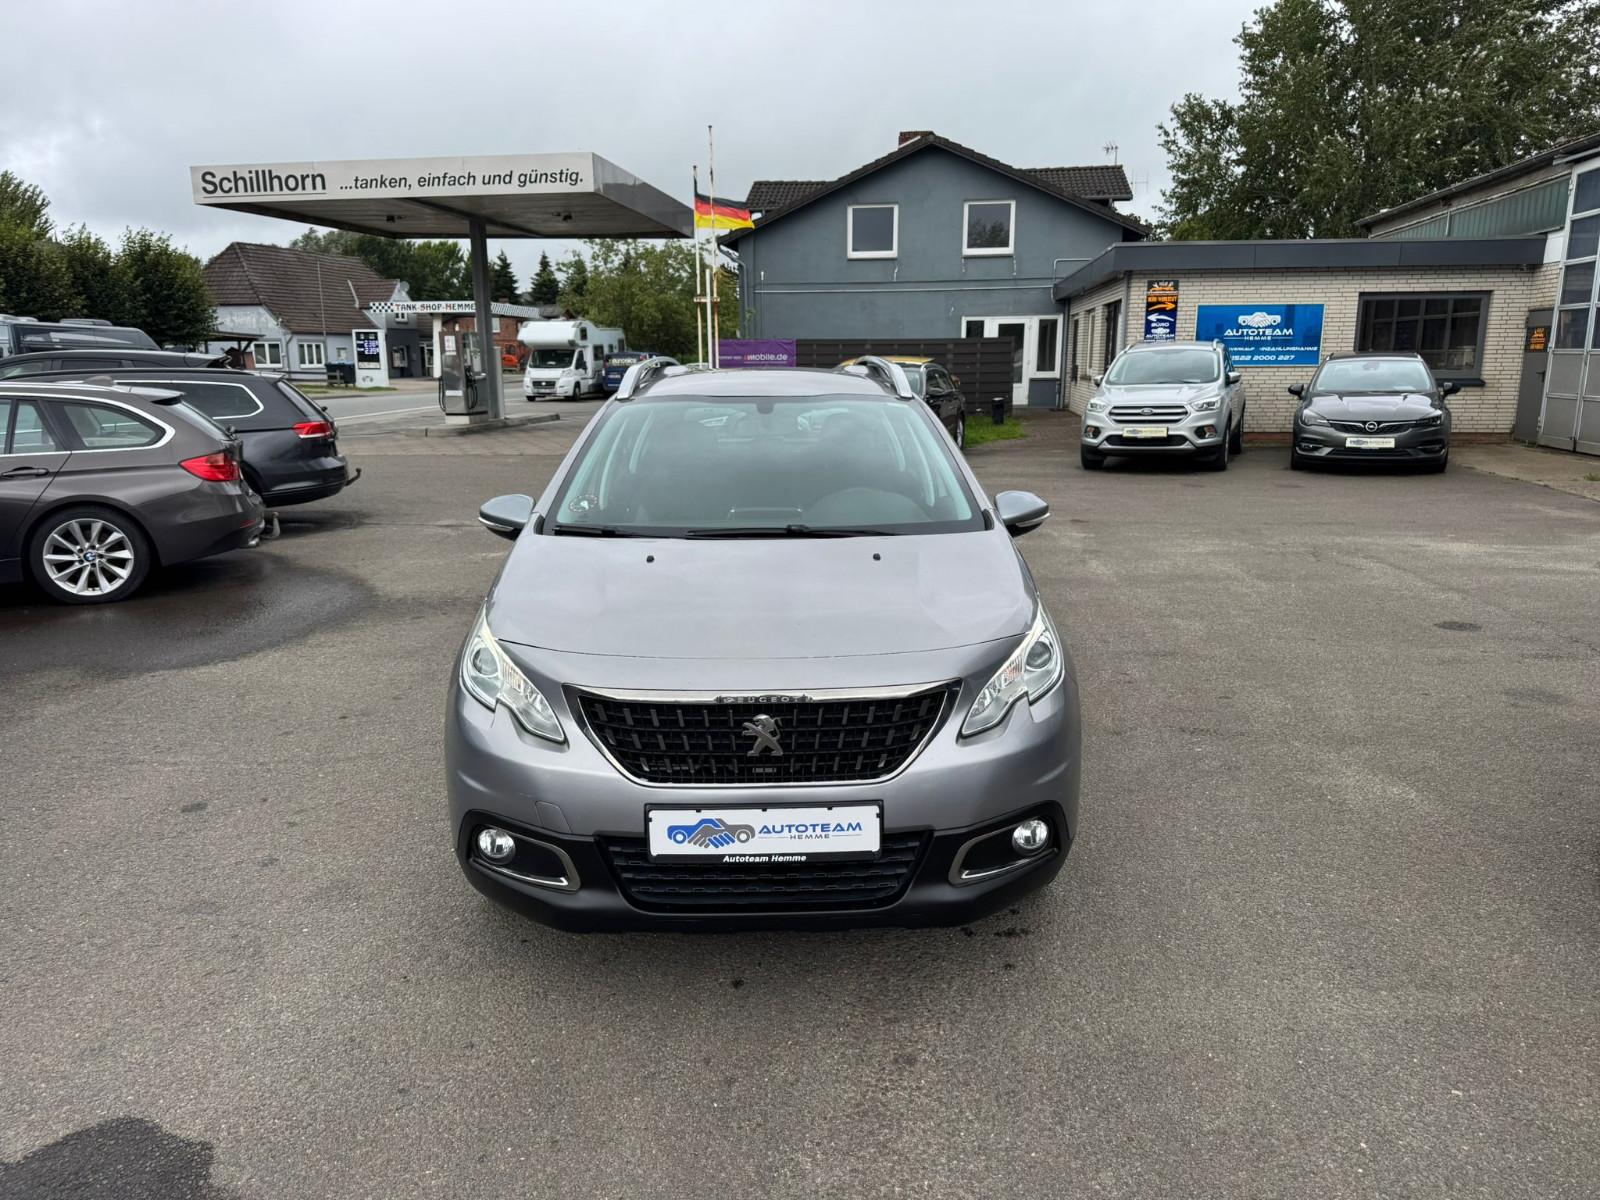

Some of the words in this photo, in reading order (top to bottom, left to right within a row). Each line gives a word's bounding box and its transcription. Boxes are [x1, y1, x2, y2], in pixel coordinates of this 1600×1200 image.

[200, 169, 327, 195] Schillhorn
[417, 172, 476, 188] einfach
[482, 170, 513, 186] und
[518, 168, 583, 187] günstig.
[1223, 328, 1293, 336] AUTOTEAM
[758, 822, 863, 835] AUTOTEAM
[789, 833, 831, 841] HEMME
[722, 854, 769, 864] Autoteam
[771, 854, 807, 863] Hemme
